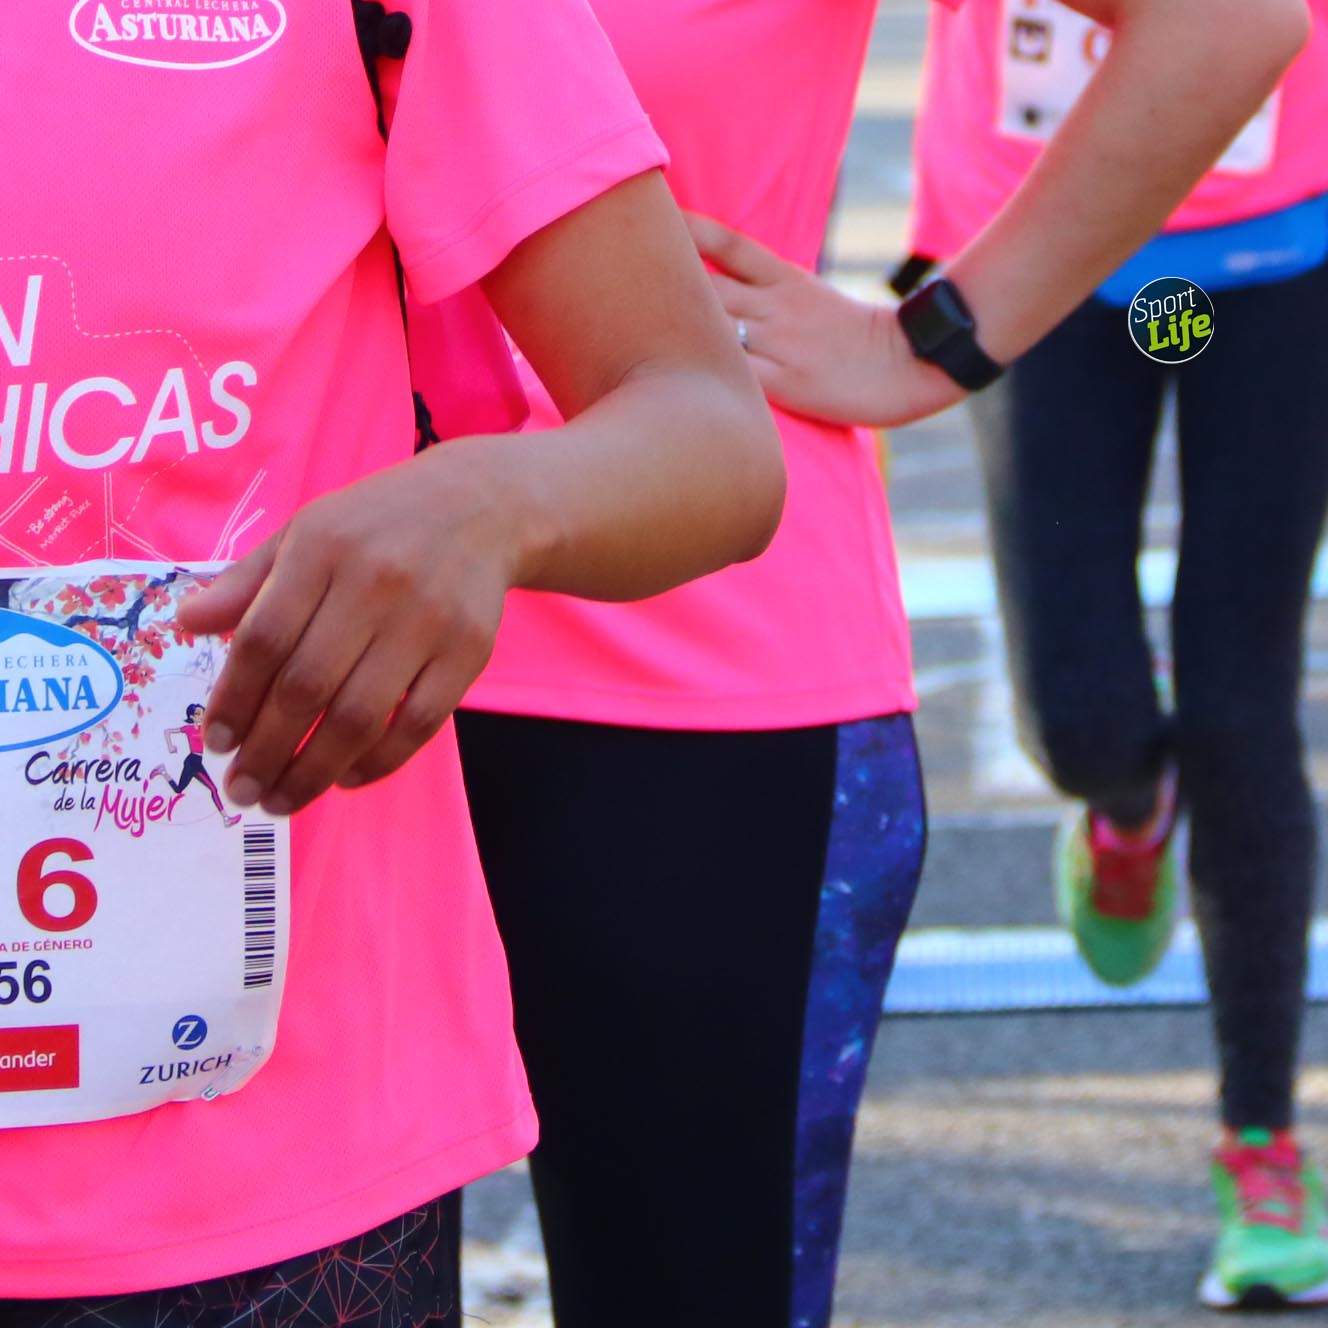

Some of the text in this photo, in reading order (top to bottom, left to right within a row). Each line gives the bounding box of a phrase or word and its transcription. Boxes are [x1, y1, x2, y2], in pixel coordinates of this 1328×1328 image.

[87, 2, 273, 43] ASTURIANA
[24, 750, 142, 786] Carrera
[53, 779, 186, 838] de la Mujer
[11, 940, 30, 953] DE
[33, 937, 94, 952] GÉNERO
[138, 1052, 234, 1085] ZURICH
